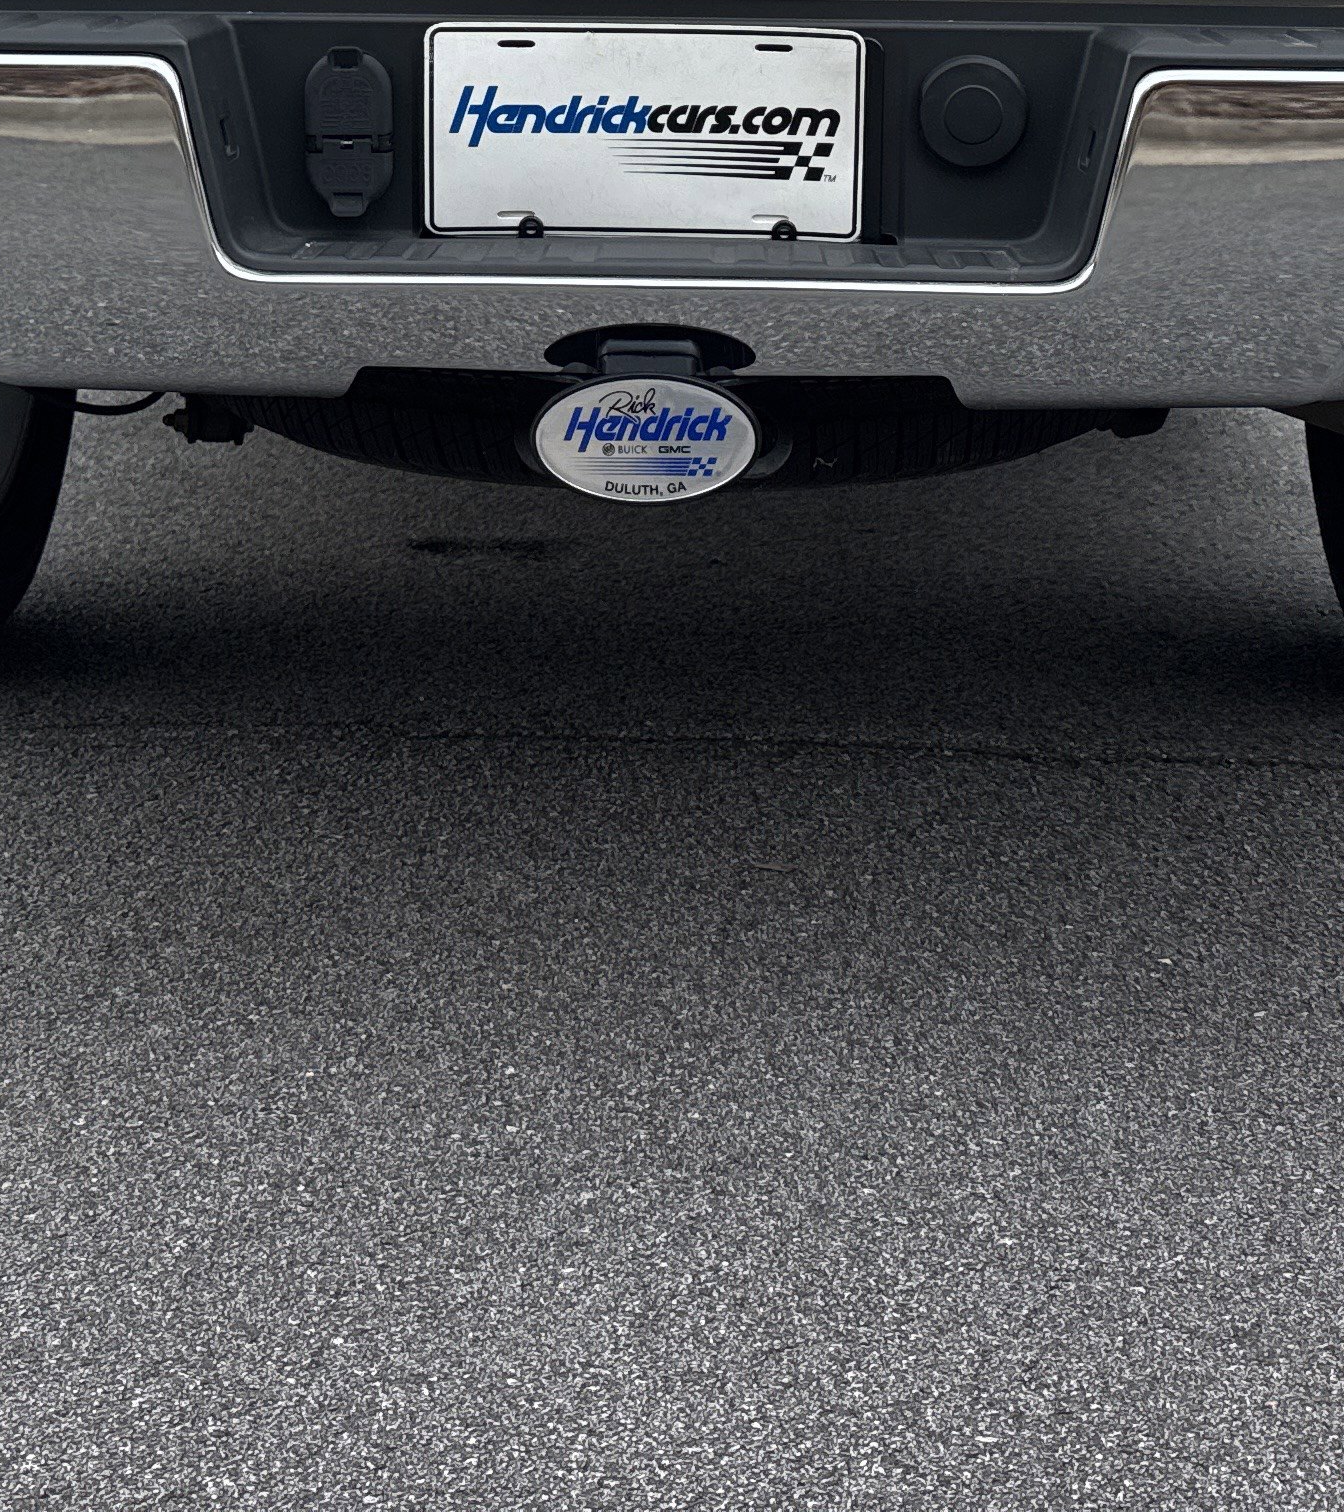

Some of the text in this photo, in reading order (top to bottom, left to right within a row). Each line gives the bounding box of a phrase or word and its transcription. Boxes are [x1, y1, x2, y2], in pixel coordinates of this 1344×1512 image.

[449, 85, 841, 148] Hendrickcars.com
[599, 387, 656, 424] Rick
[563, 406, 733, 453] Hendrick
[617, 445, 691, 455] BUICK GMC
[605, 480, 687, 496] DULUTH, GA
